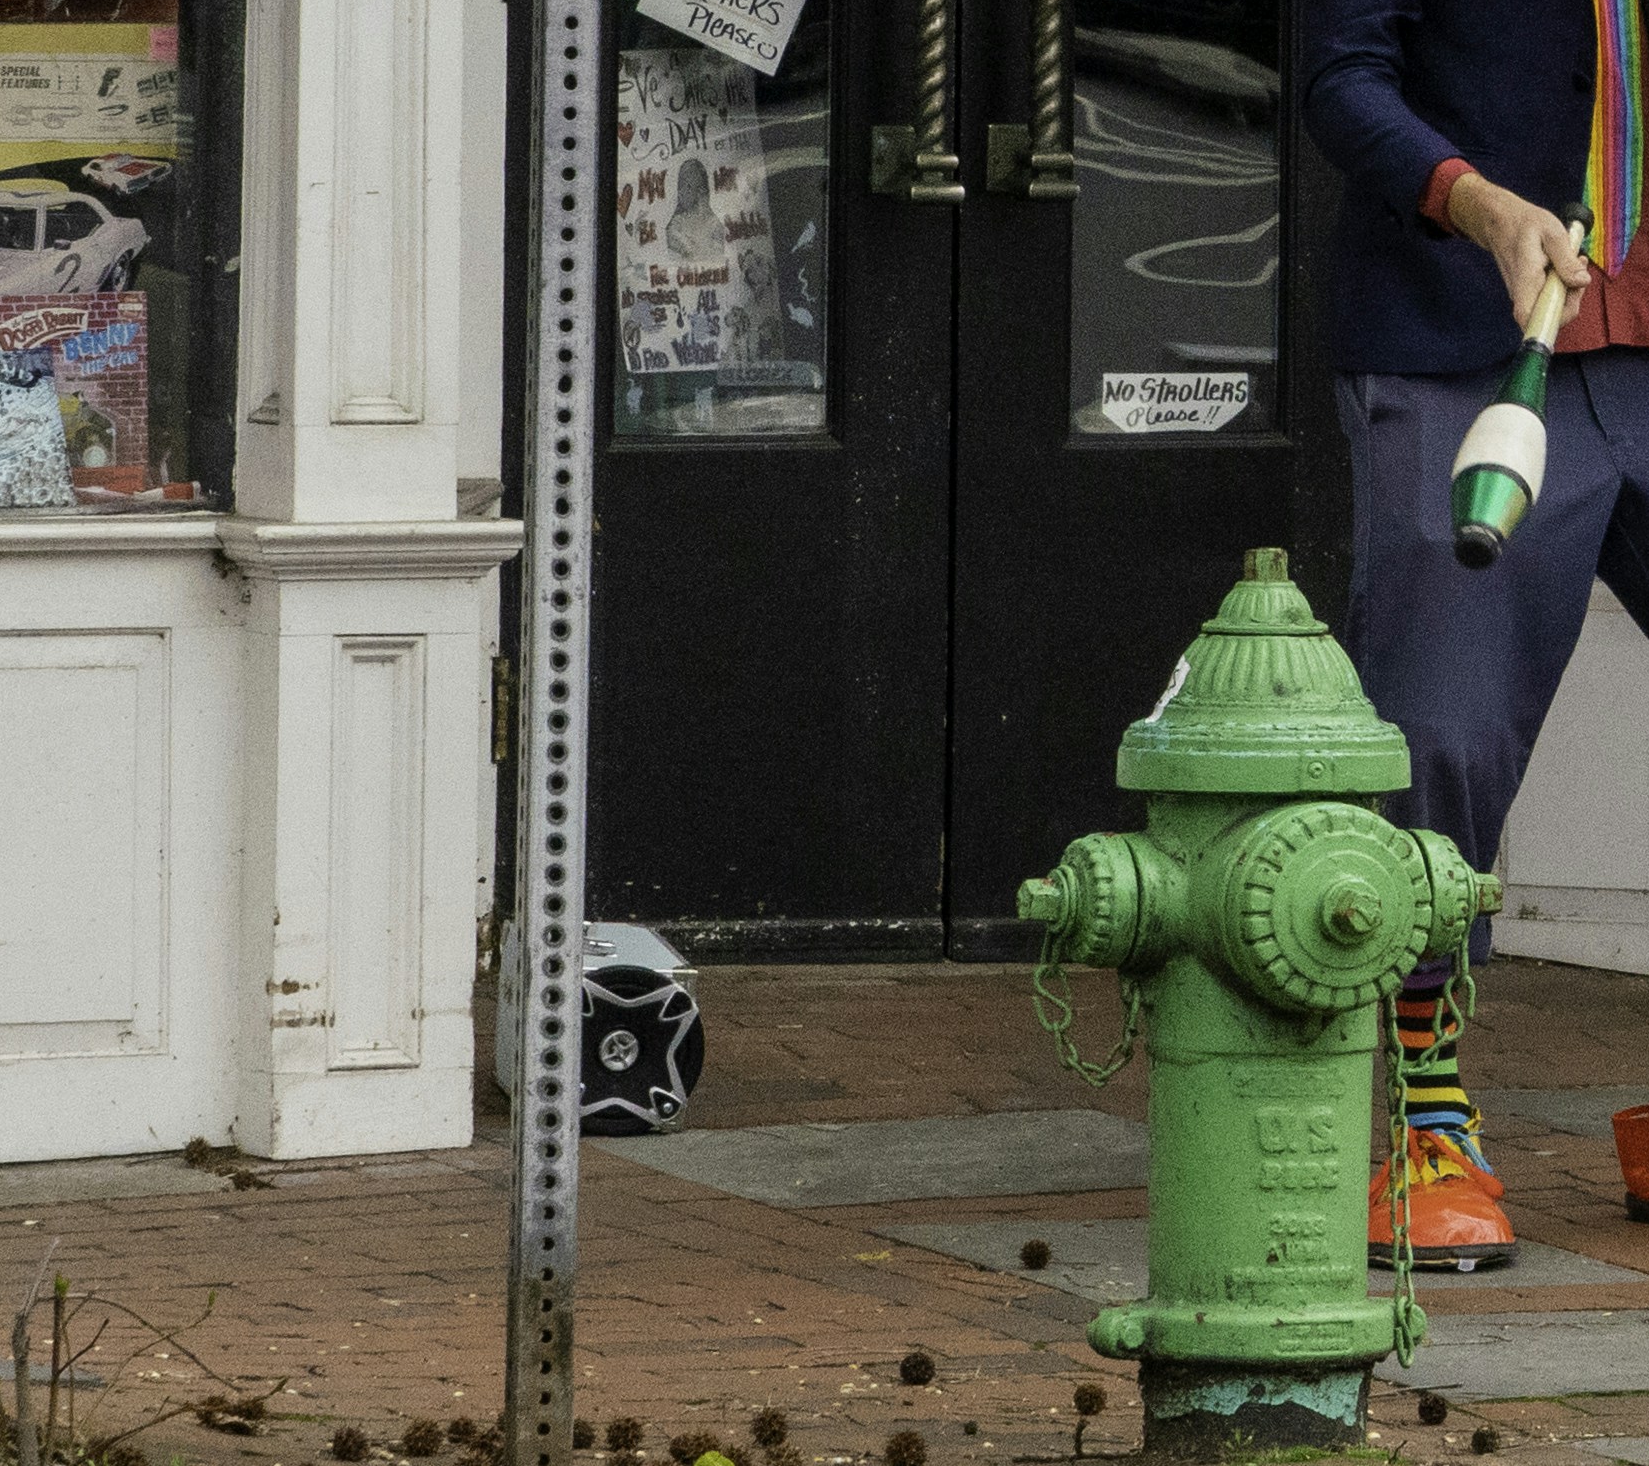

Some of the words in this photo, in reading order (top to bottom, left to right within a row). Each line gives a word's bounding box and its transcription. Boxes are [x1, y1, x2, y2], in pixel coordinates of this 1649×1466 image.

[0, 66, 42, 78] SPECIAL
[0, 78, 51, 90] FEATURES
[1104, 379, 1136, 405] NO
